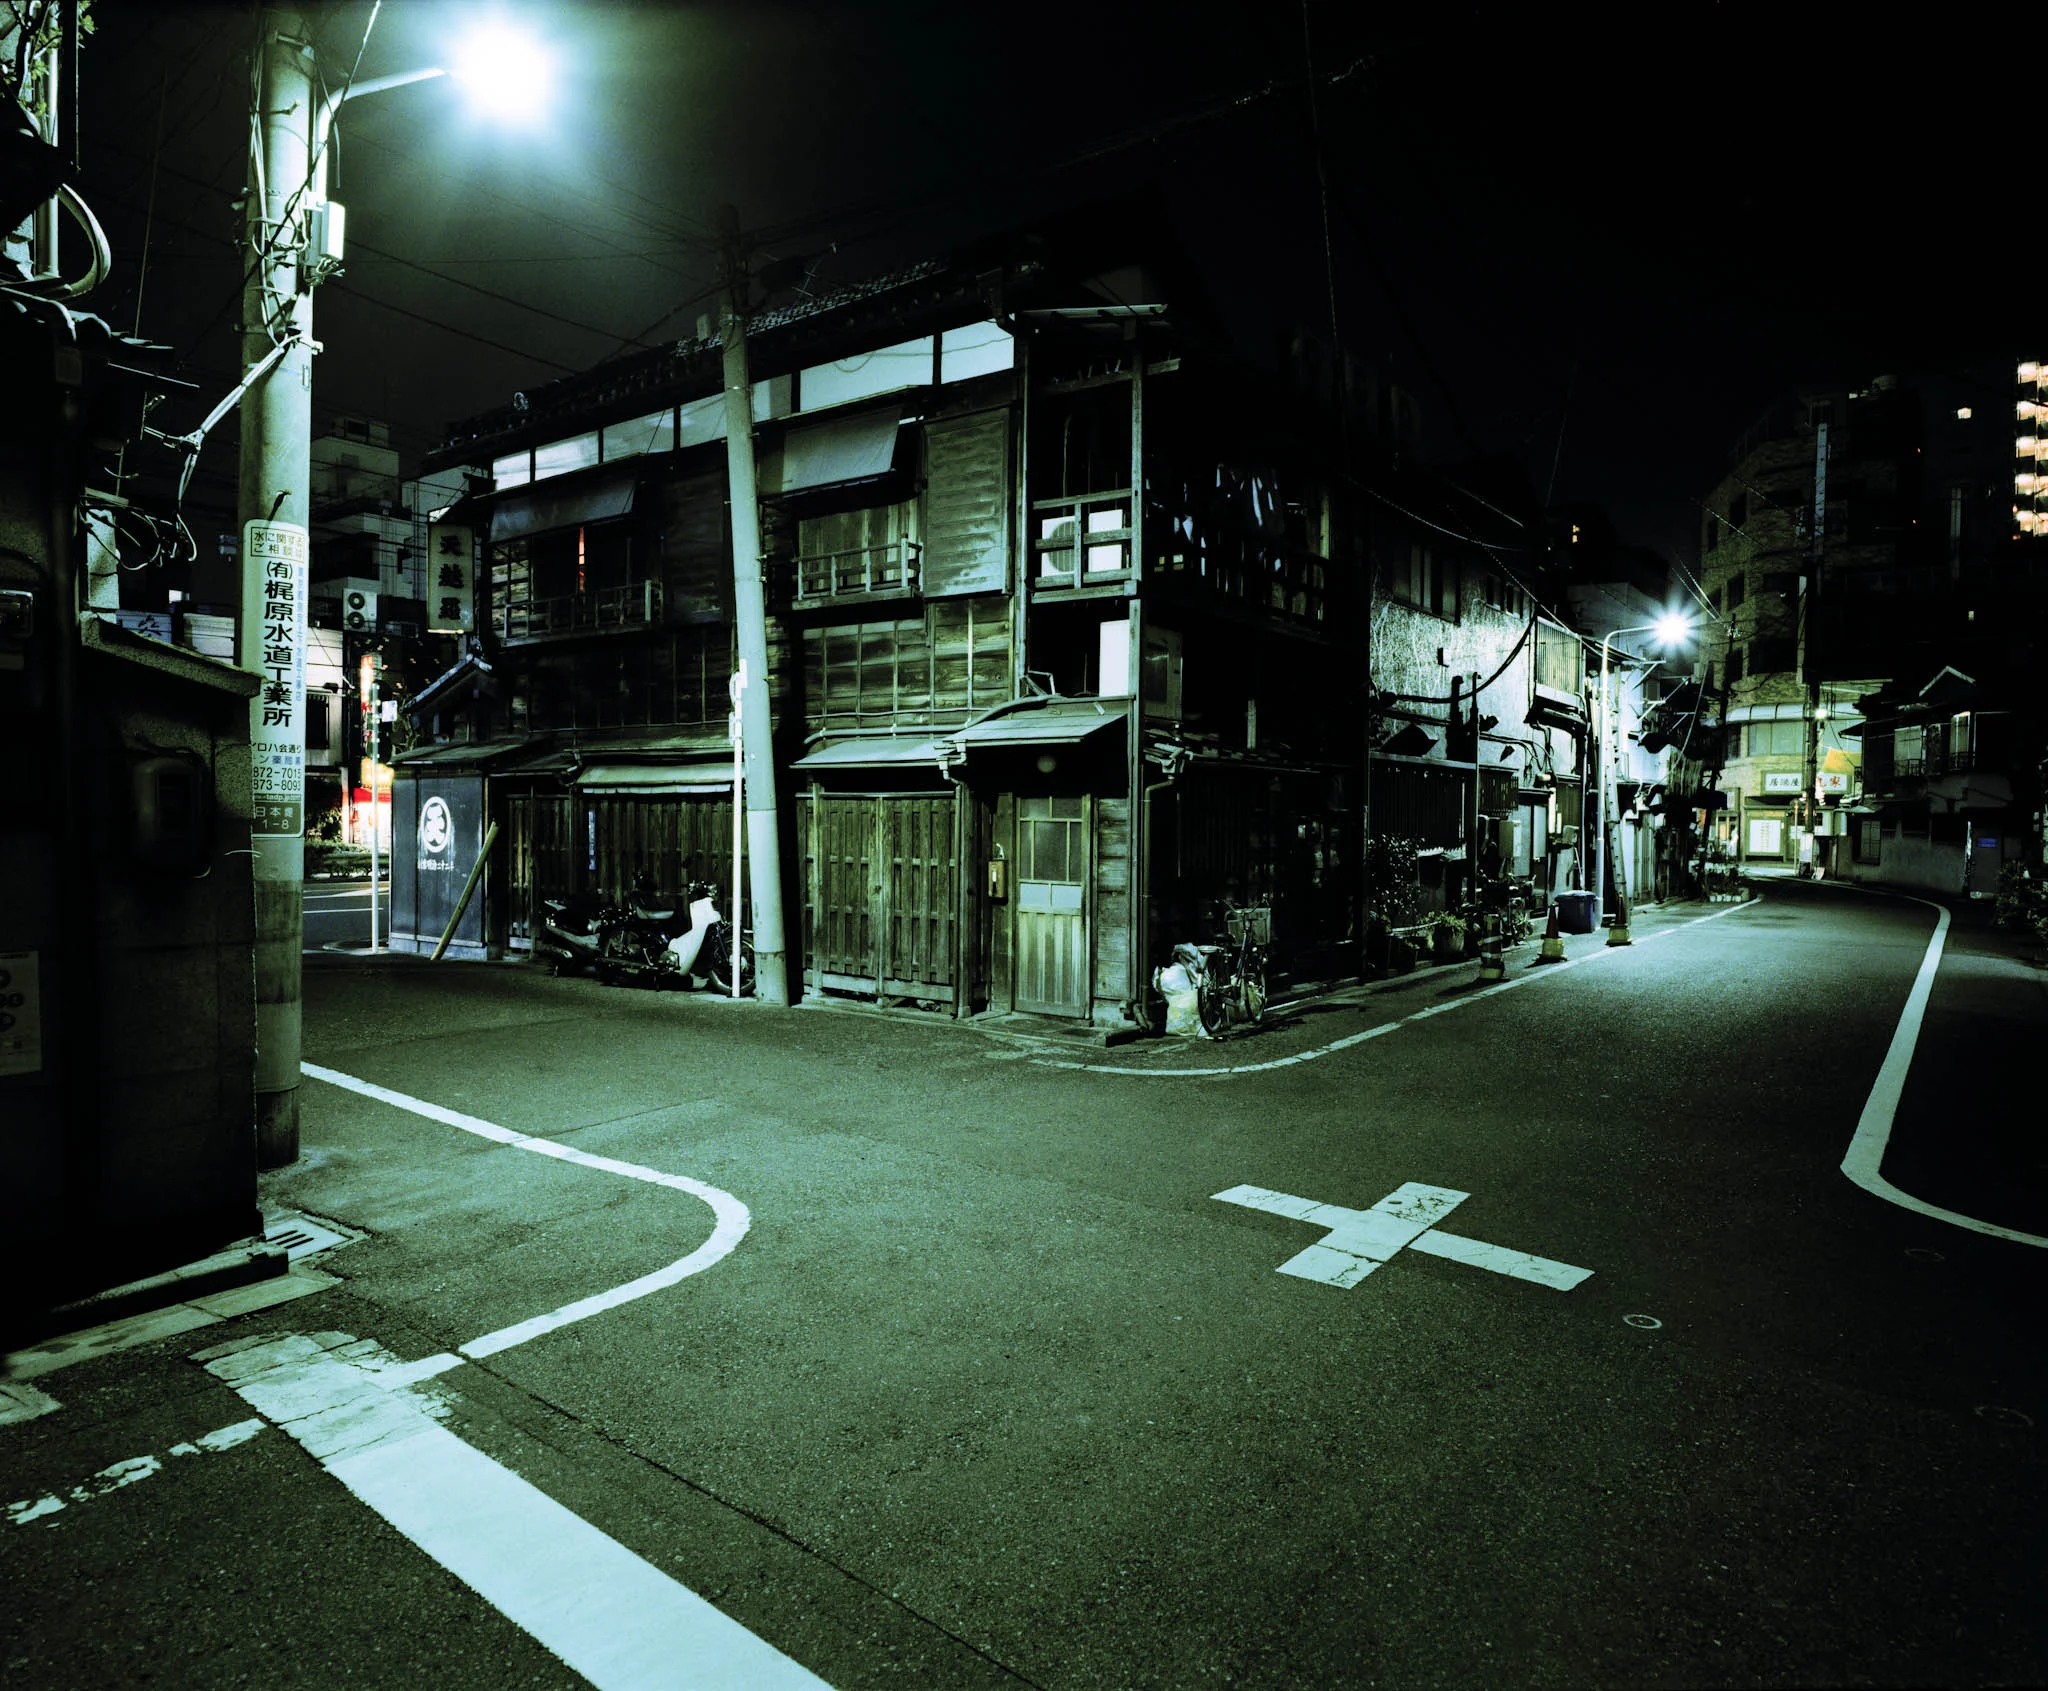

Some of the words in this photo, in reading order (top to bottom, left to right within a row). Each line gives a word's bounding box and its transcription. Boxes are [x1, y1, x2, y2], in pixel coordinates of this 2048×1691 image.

[263, 561, 294, 727] (有)梶原水道工業所
